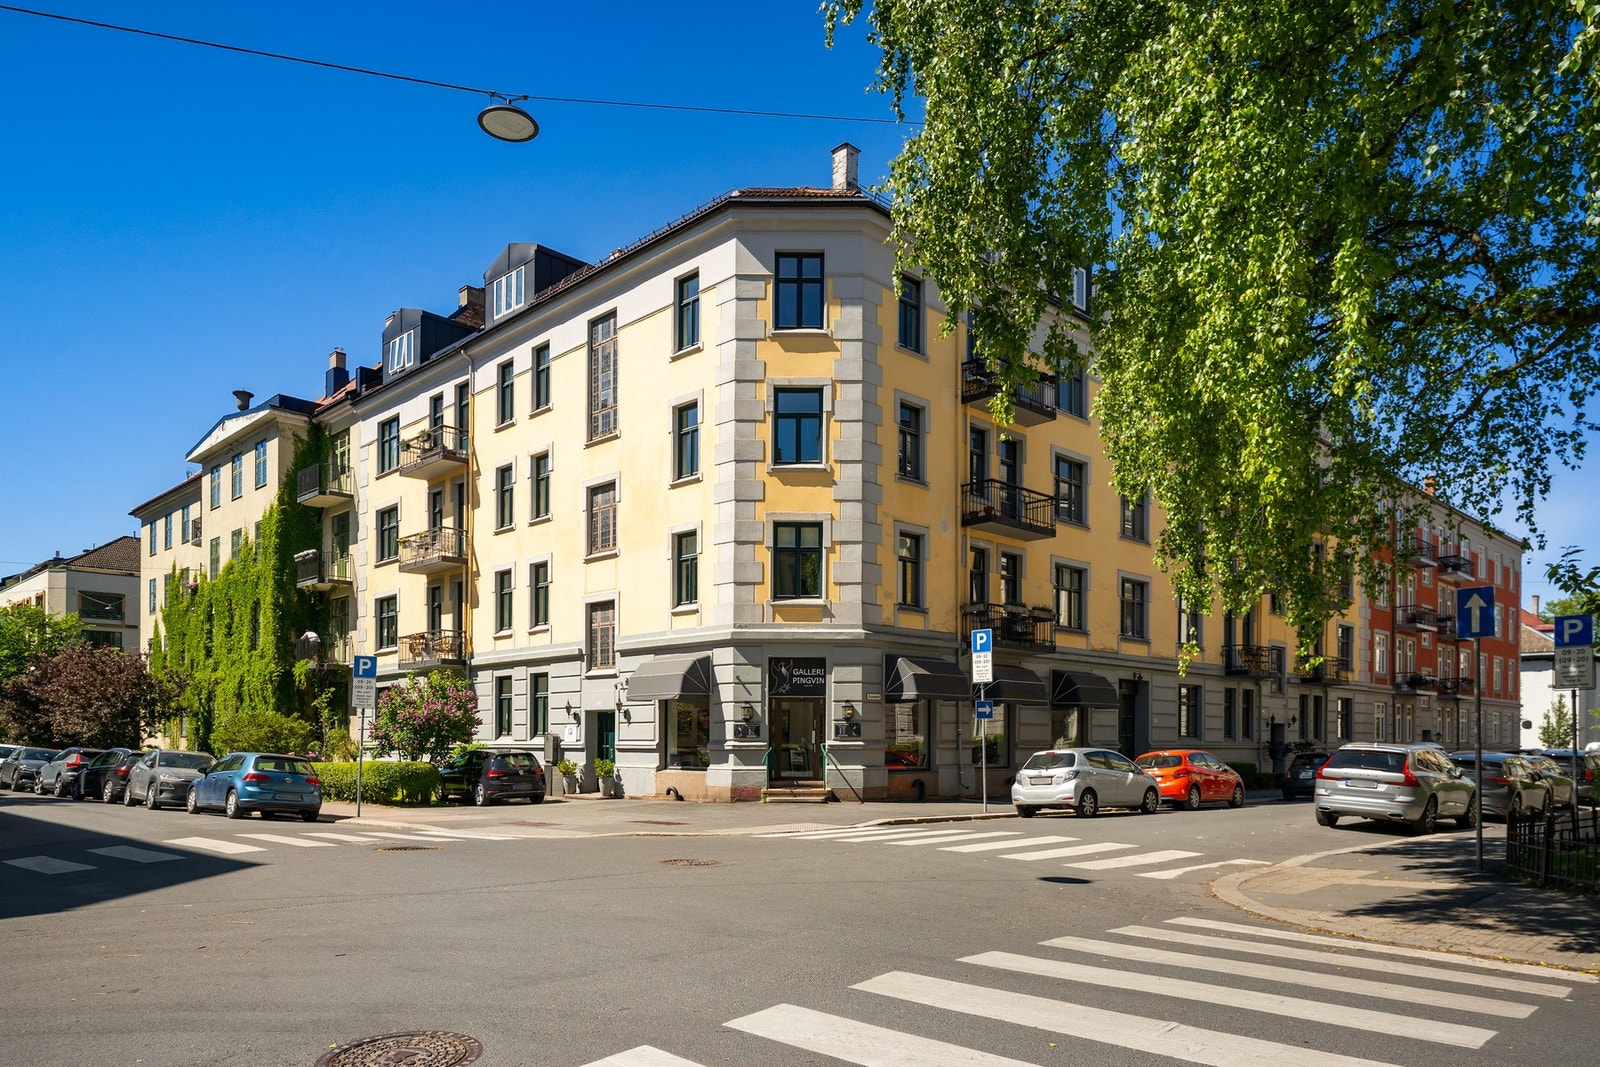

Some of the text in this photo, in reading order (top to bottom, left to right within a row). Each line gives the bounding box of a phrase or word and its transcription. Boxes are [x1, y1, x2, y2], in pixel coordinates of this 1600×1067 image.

[1564, 618, 1584, 644] P
[976, 632, 987, 650] P
[359, 658, 372, 676] P
